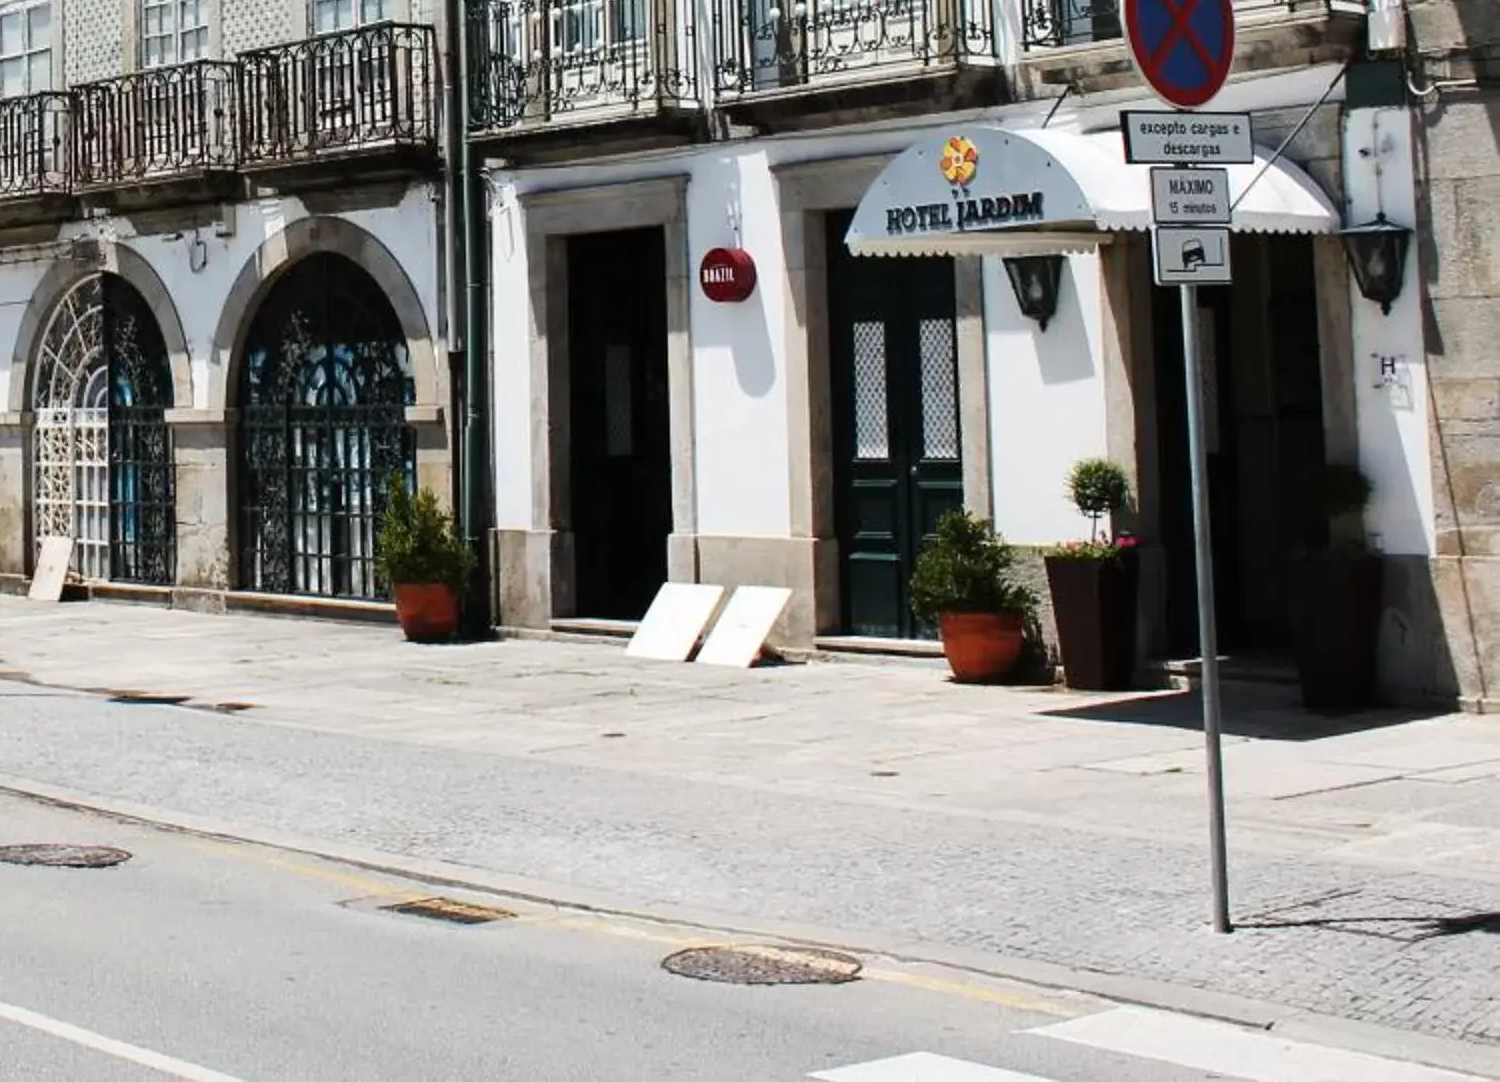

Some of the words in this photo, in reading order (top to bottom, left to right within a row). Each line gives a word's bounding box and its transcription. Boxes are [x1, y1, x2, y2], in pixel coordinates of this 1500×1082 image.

[1139, 122, 1187, 136] excepto
[1191, 123, 1228, 137] cargas
[1233, 124, 1240, 135] e
[1163, 142, 1221, 158] descargas
[885, 202, 951, 235] HOTEL
[955, 191, 1045, 231] JARDIM
[1169, 203, 1179, 215] 15
[1183, 203, 1217, 215] minutos
